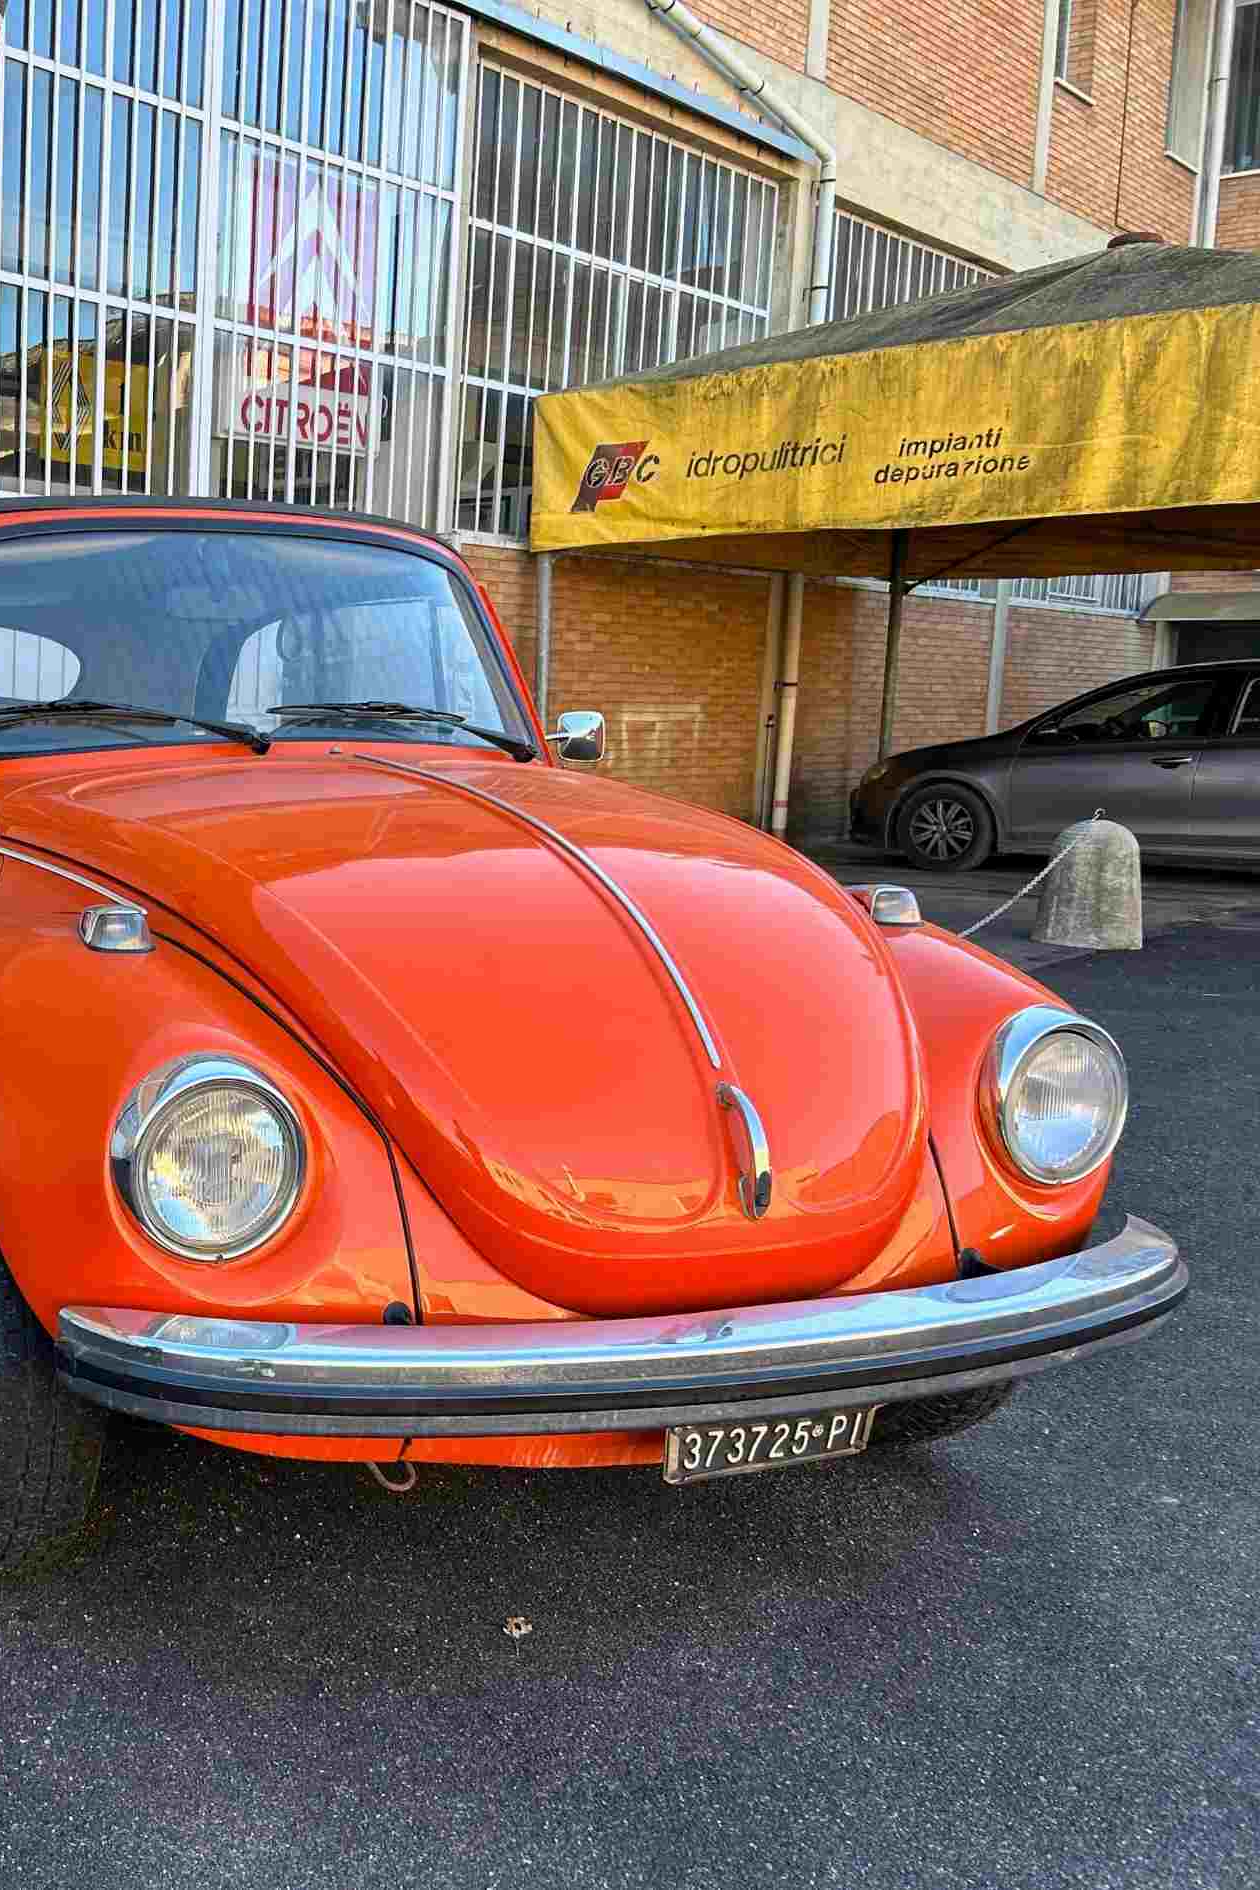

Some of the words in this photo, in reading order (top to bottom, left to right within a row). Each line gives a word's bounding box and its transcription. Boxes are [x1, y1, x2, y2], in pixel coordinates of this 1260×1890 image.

[240, 391, 372, 448] CITROËN
[898, 427, 1003, 459] impianti
[585, 453, 660, 488] GBC
[685, 434, 847, 480] idropulitrici
[873, 455, 1031, 486] depurazione
[683, 1420, 813, 1470] 373725
